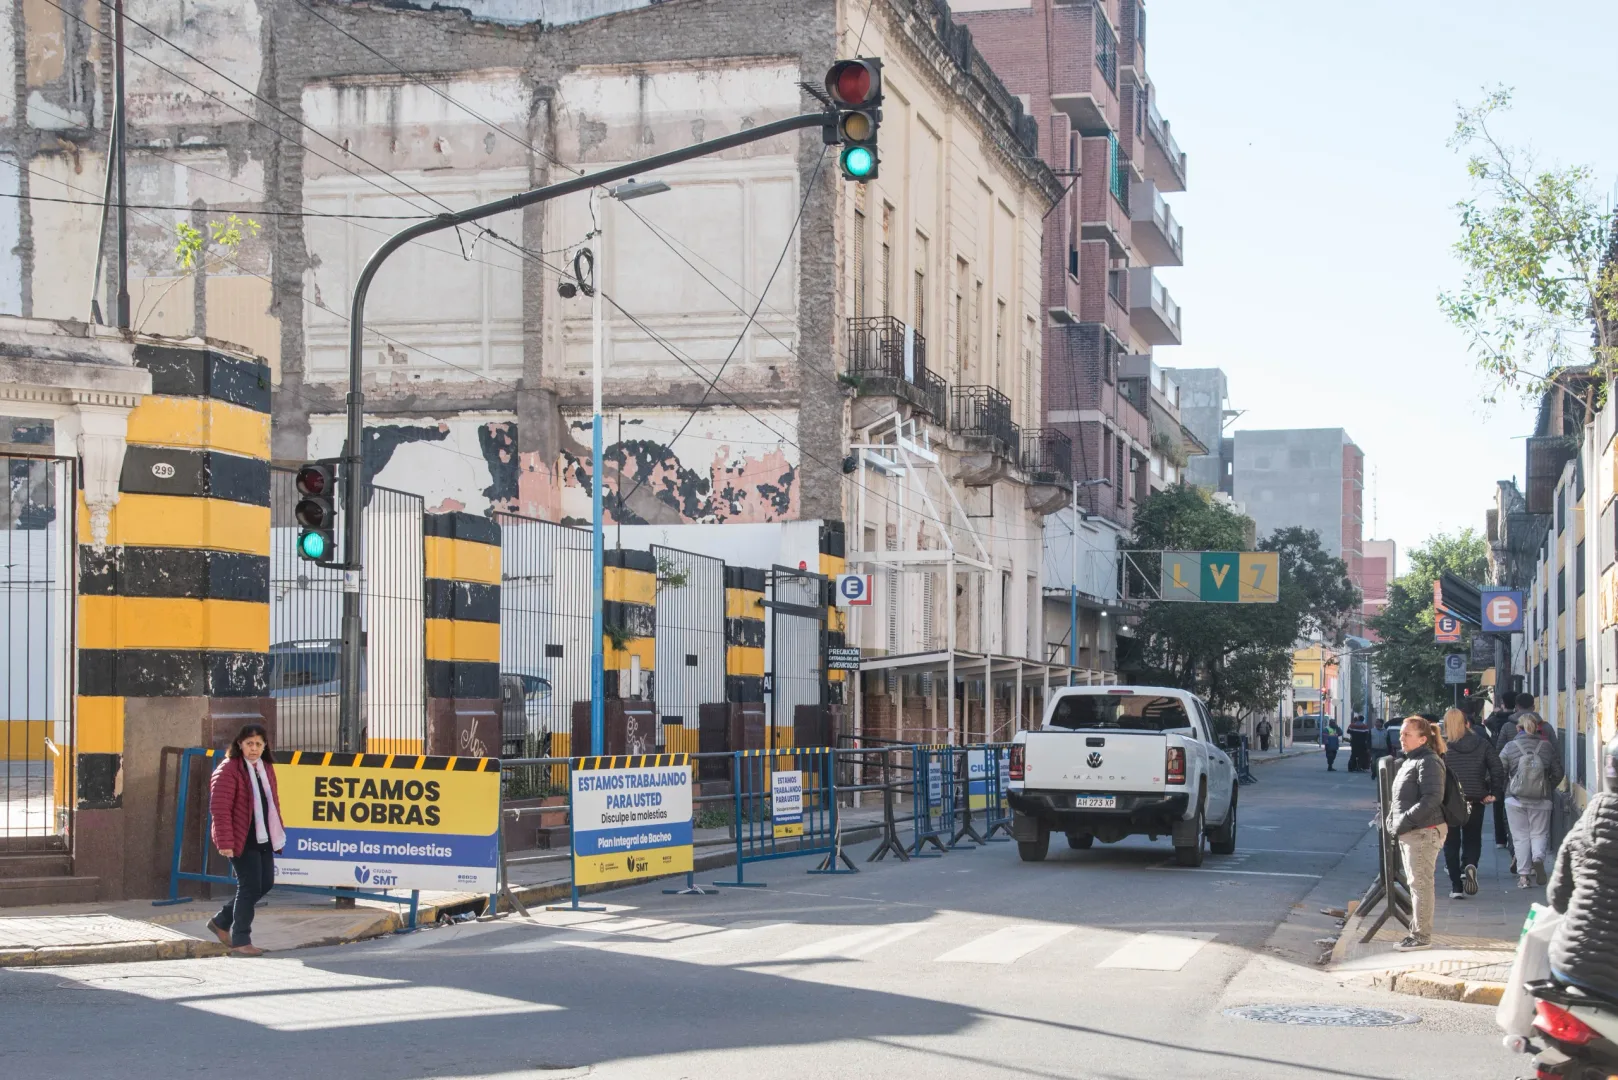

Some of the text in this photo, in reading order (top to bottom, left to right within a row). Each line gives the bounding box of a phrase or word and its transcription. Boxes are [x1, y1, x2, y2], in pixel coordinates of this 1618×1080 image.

[154, 465, 173, 475] 299
[846, 580, 859, 595] E
[1493, 600, 1511, 623] E
[1443, 618, 1453, 631] E
[1450, 657, 1459, 668] E
[578, 771, 687, 792] ESTAMOS TRABAJANDO
[777, 776, 797, 784] ESTAMOS
[314, 776, 441, 802] ESTAMOS
[607, 792, 662, 809] PARA USTED
[1077, 799, 1088, 807] AH
[1089, 799, 1103, 807] 273
[312, 801, 441, 827] EN OBRAS
[601, 809, 668, 825] Disculpe la molestias
[598, 832, 672, 849] Plan Integral de Bacheo
[297, 838, 452, 859] Disculpe las molestias
[635, 862, 648, 872] SMT
[372, 875, 398, 886] SMT
